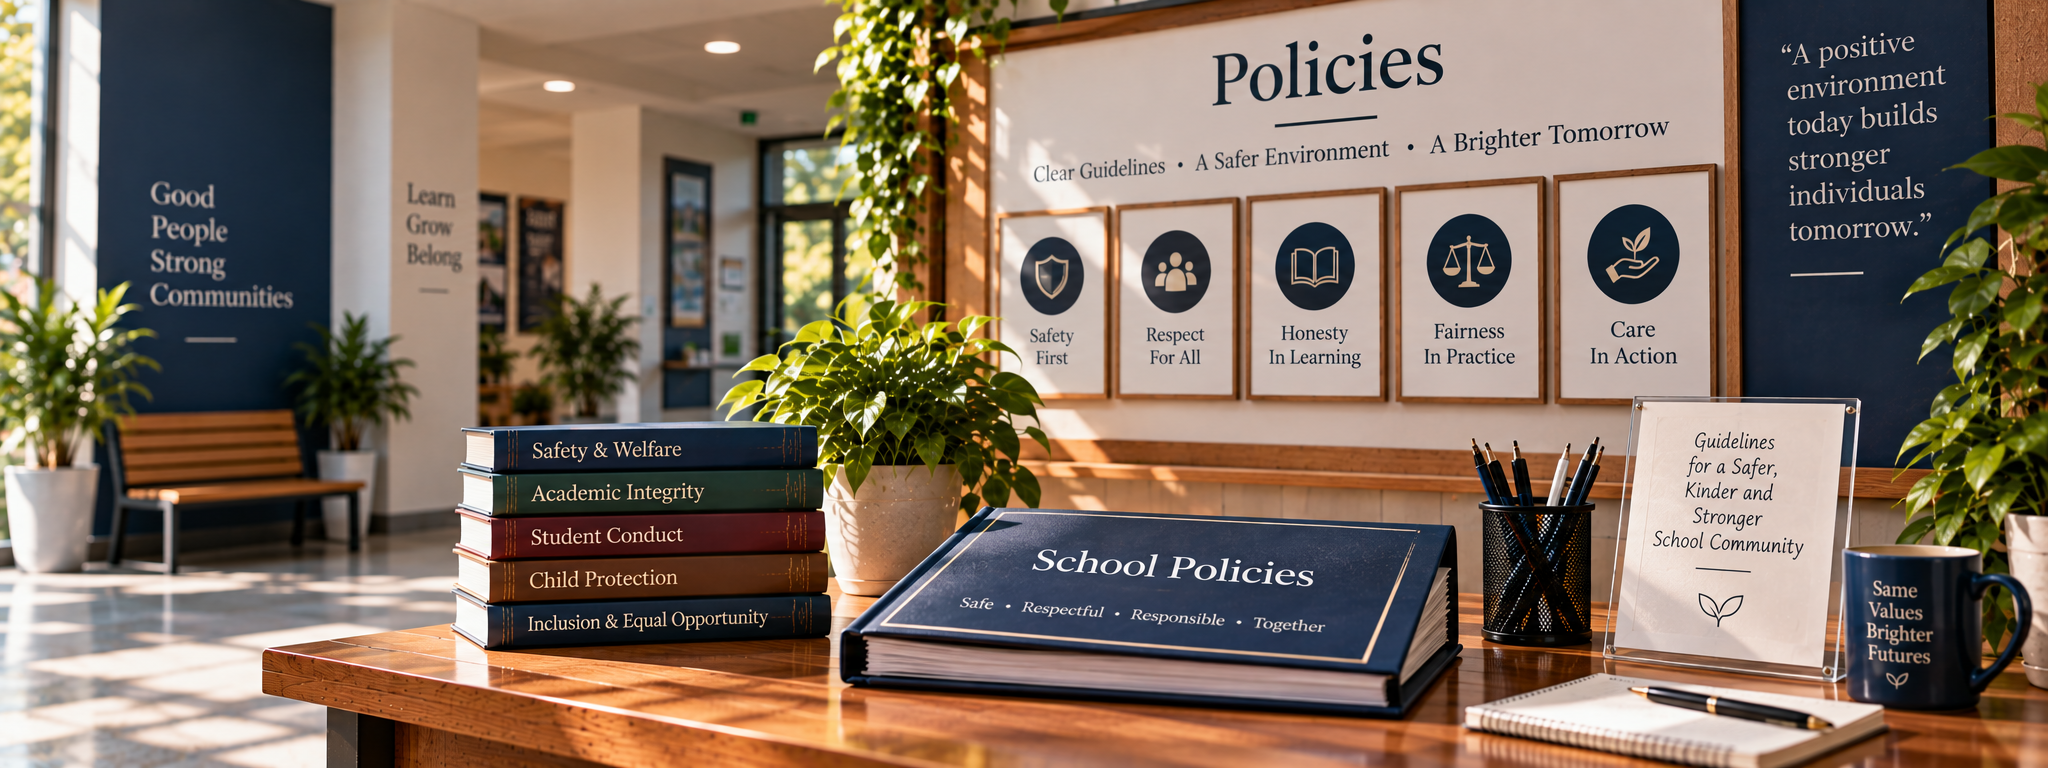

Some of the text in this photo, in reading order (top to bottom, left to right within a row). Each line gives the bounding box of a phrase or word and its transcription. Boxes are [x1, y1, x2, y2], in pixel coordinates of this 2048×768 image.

[1781, 32, 1915, 68] “A positive
[1212, 33, 1444, 106] Policies
[1787, 65, 1947, 100] environment
[1787, 101, 1938, 137] today builds
[1033, 121, 1670, 183] Clear Guidelines A Safer Environment A Brighter Tomorrow
[1788, 147, 1890, 172] stronger
[150, 181, 215, 208] Good
[407, 183, 456, 208] Learn
[1789, 176, 1925, 207] individuals
[151, 215, 228, 247] People
[406, 213, 452, 236] Grow
[1790, 212, 1932, 242] tomorrow.”
[150, 249, 226, 281] Strong
[407, 244, 463, 273] Belong
[150, 283, 293, 309] Communities
[1029, 328, 1074, 346] Safety
[1146, 328, 1205, 345] Respect
[1281, 325, 1348, 344] Honesty
[1434, 322, 1505, 339] Fairness
[1610, 321, 1656, 338] Care
[1036, 350, 1068, 365] First
[1150, 349, 1201, 365] For All
[1269, 349, 1361, 368] In Learning
[1424, 348, 1516, 365] In Practice
[1590, 347, 1678, 364] In Action
[532, 440, 682, 463] Safety & Welfare
[1695, 432, 1775, 451] Guidelines
[1687, 457, 1778, 480] for a Safer,
[531, 483, 705, 504] Academic Integrity
[1685, 482, 1773, 500] Kinder and
[1693, 507, 1763, 531] Stronger
[531, 526, 683, 546] Student Conduct
[1653, 530, 1804, 560] School Community
[530, 569, 678, 589] Child Protection
[1032, 548, 1314, 588] School Policies
[1873, 580, 1918, 598] Same
[528, 609, 768, 632] Inclusion & Equal Opportunity
[960, 596, 1326, 634] Safe Respectful Responsible Together
[1868, 602, 1923, 620] Values
[1866, 623, 1933, 645] Brighter
[1868, 645, 1931, 664] Futures
